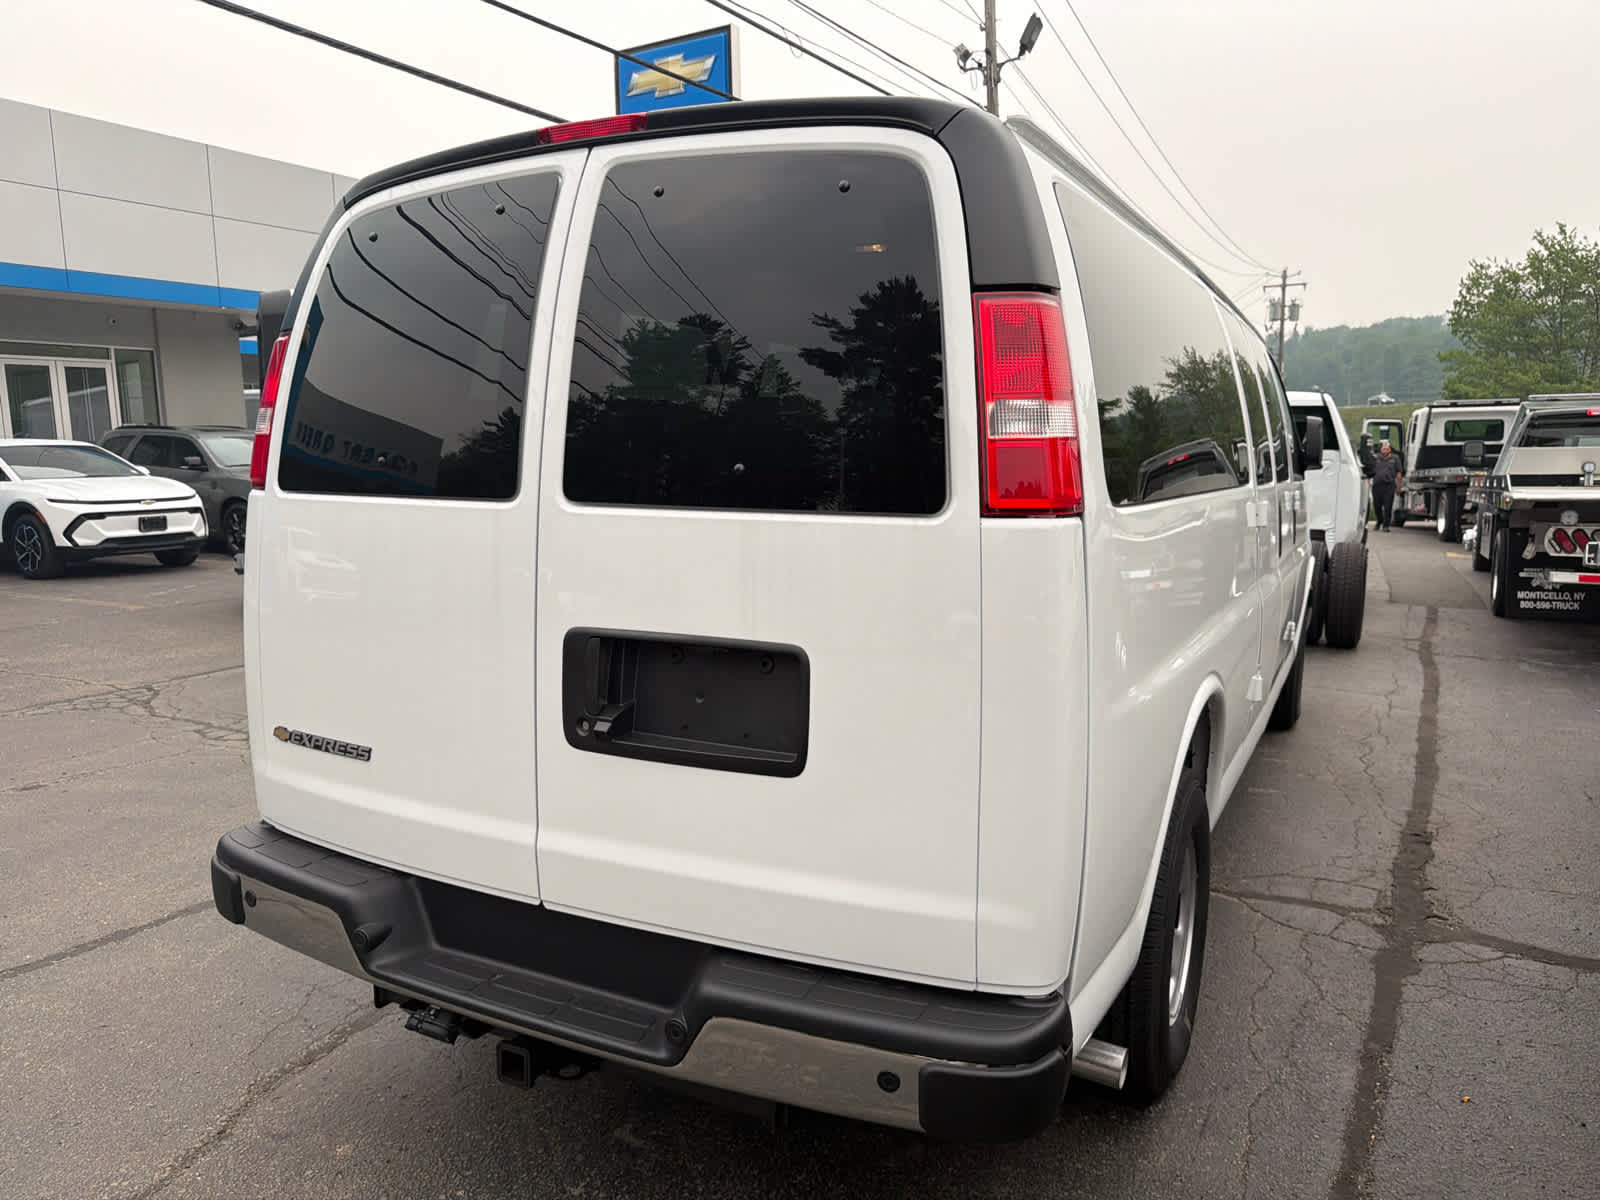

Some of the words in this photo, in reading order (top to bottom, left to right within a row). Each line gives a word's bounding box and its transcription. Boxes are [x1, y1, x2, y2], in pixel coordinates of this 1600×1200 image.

[1517, 591, 1572, 601] MONTICELLO,
[1574, 592, 1586, 600] NY
[290, 730, 371, 761] EXPRESS
